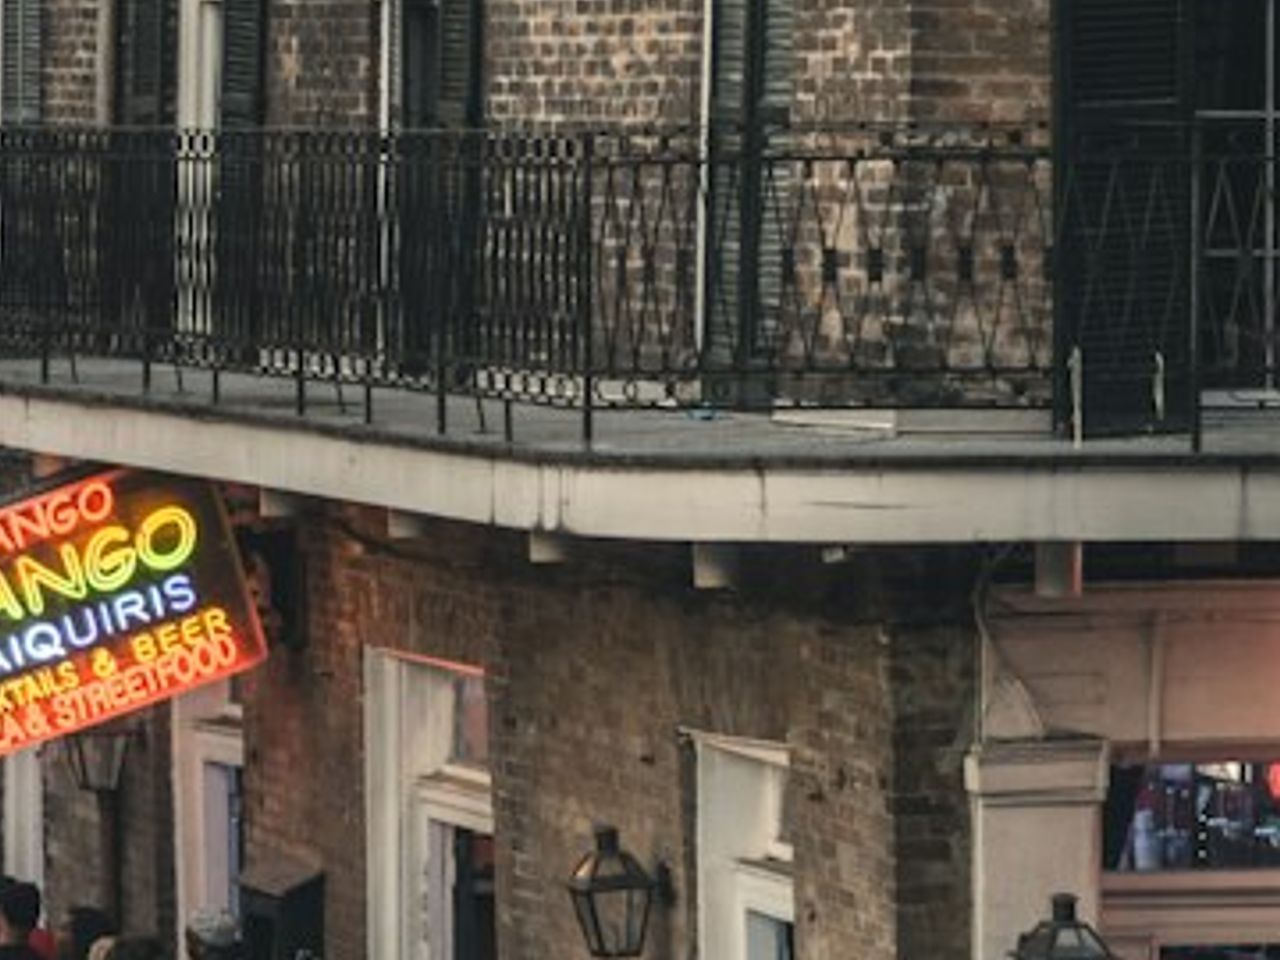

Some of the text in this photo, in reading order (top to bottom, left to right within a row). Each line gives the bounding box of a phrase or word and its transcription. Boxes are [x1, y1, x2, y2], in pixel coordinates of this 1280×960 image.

[91, 647, 116, 679] &
[133, 608, 233, 662] BEER
[24, 704, 50, 736] &
